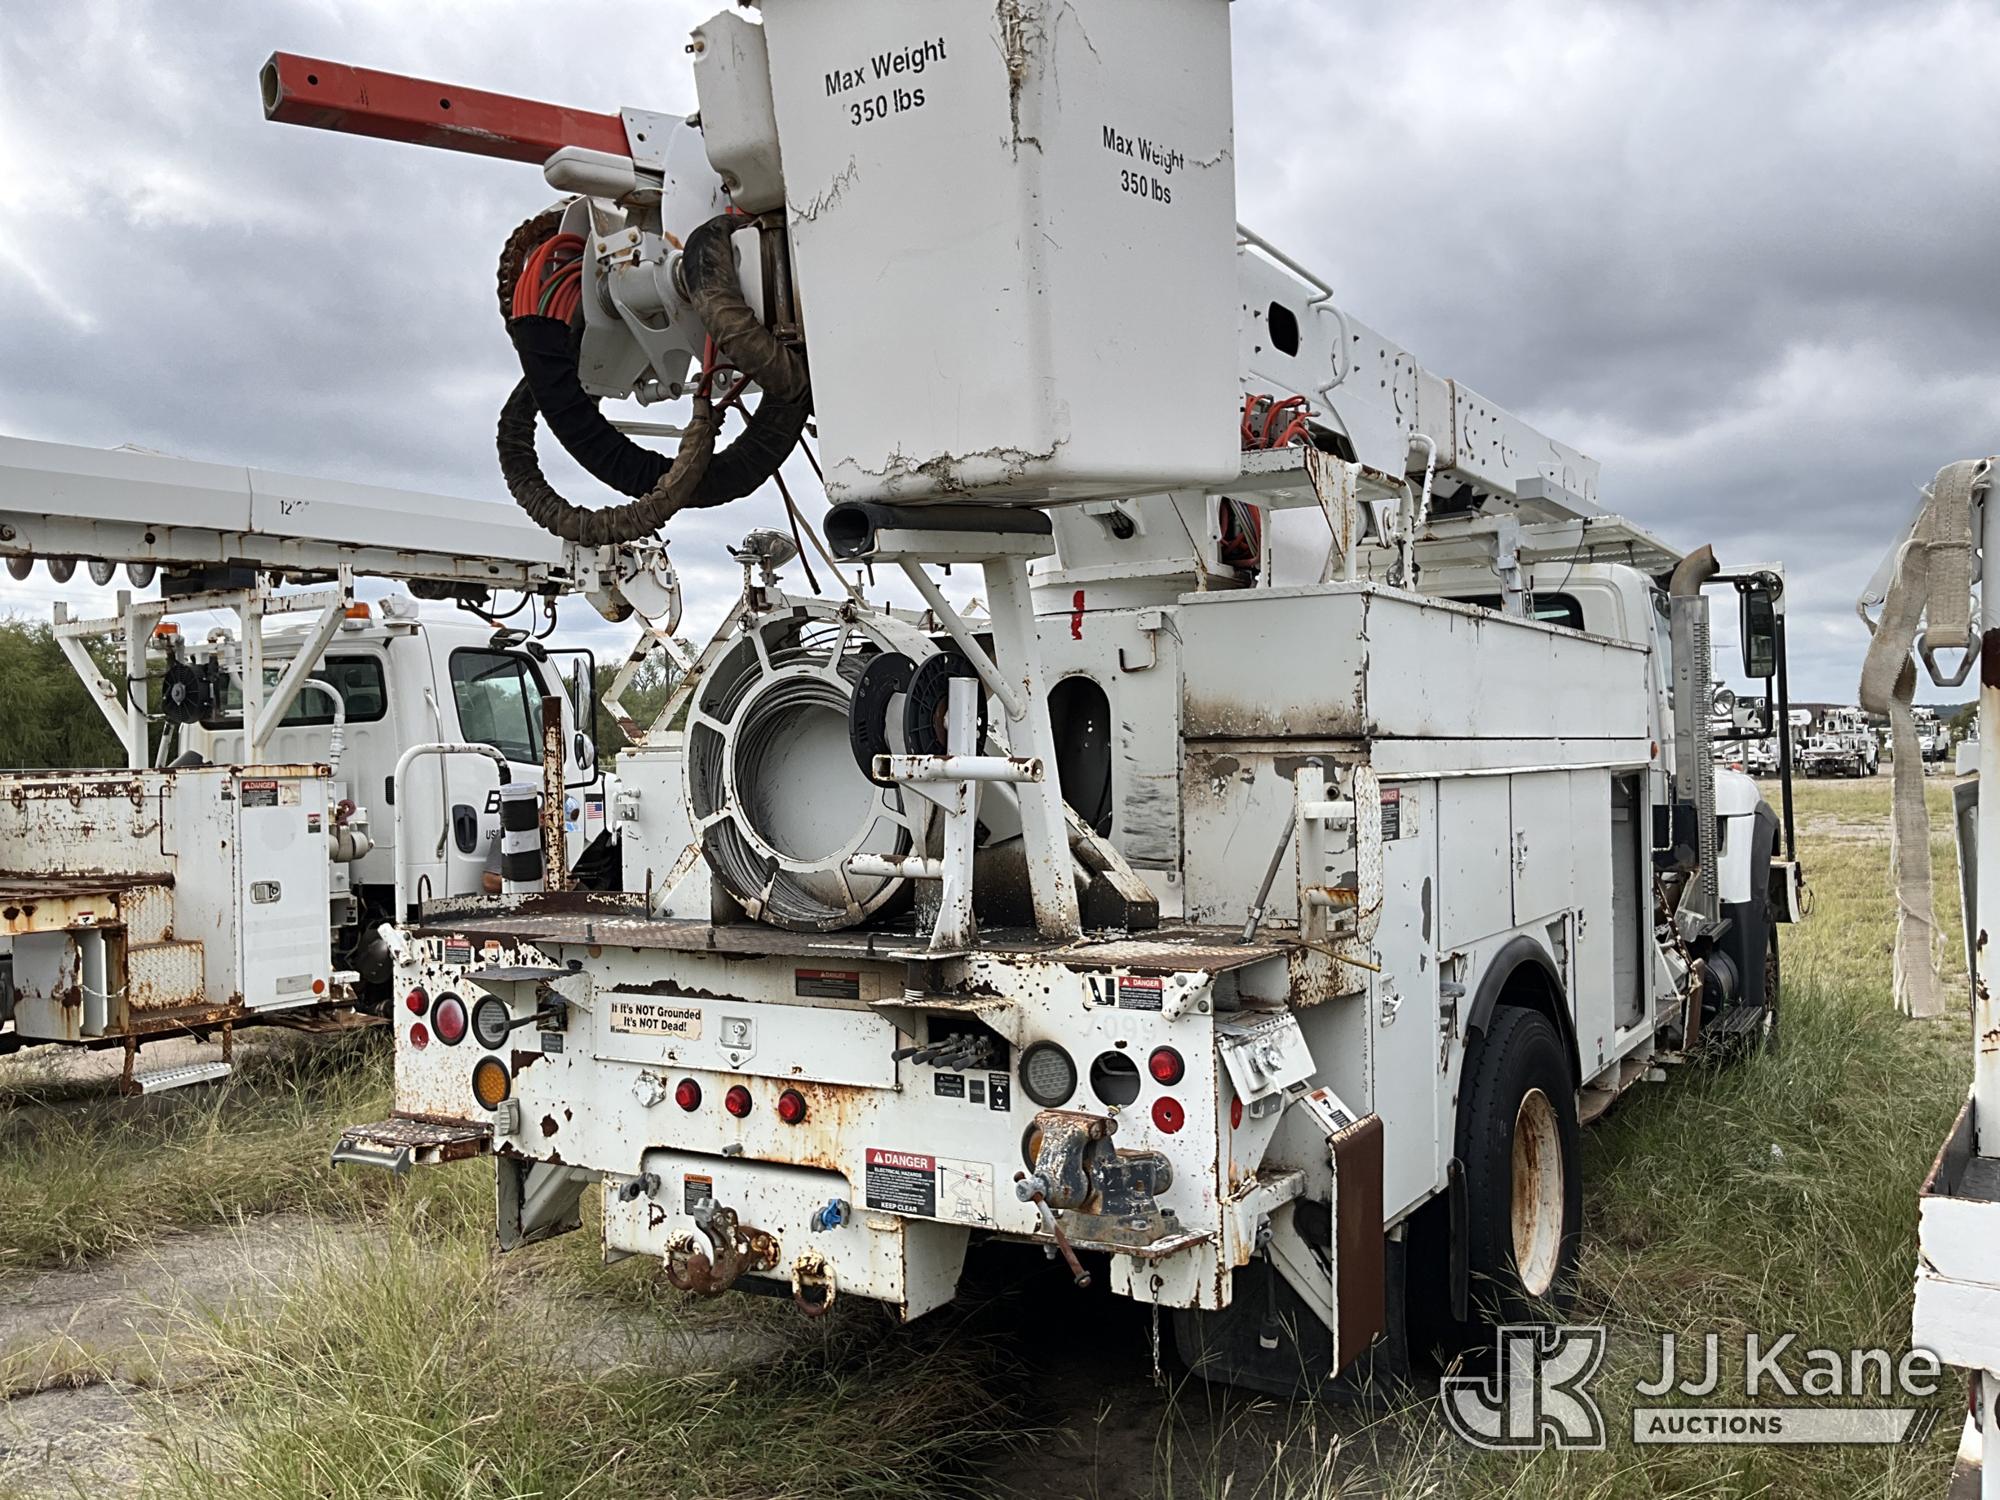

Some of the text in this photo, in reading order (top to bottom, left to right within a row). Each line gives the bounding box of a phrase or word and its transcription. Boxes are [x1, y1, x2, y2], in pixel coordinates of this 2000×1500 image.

[825, 37, 947, 97] Max Weight
[850, 88, 926, 126] 350 lbs
[1103, 125, 1185, 175] Max Weight
[1121, 169, 1172, 204] 350 lbs
[250, 781, 276, 790] DANGER
[1132, 979, 1160, 988] DANGER
[620, 1004, 633, 1015] It's
[635, 1005, 655, 1016] NOT
[657, 1006, 701, 1020] Grounded
[624, 1016, 687, 1032] It's NOT Dead!
[884, 1153, 928, 1169] DANGER
[874, 1166, 922, 1178] ELECTRICAL HAZARDS
[881, 1201, 918, 1213] KEEP CLEAR
